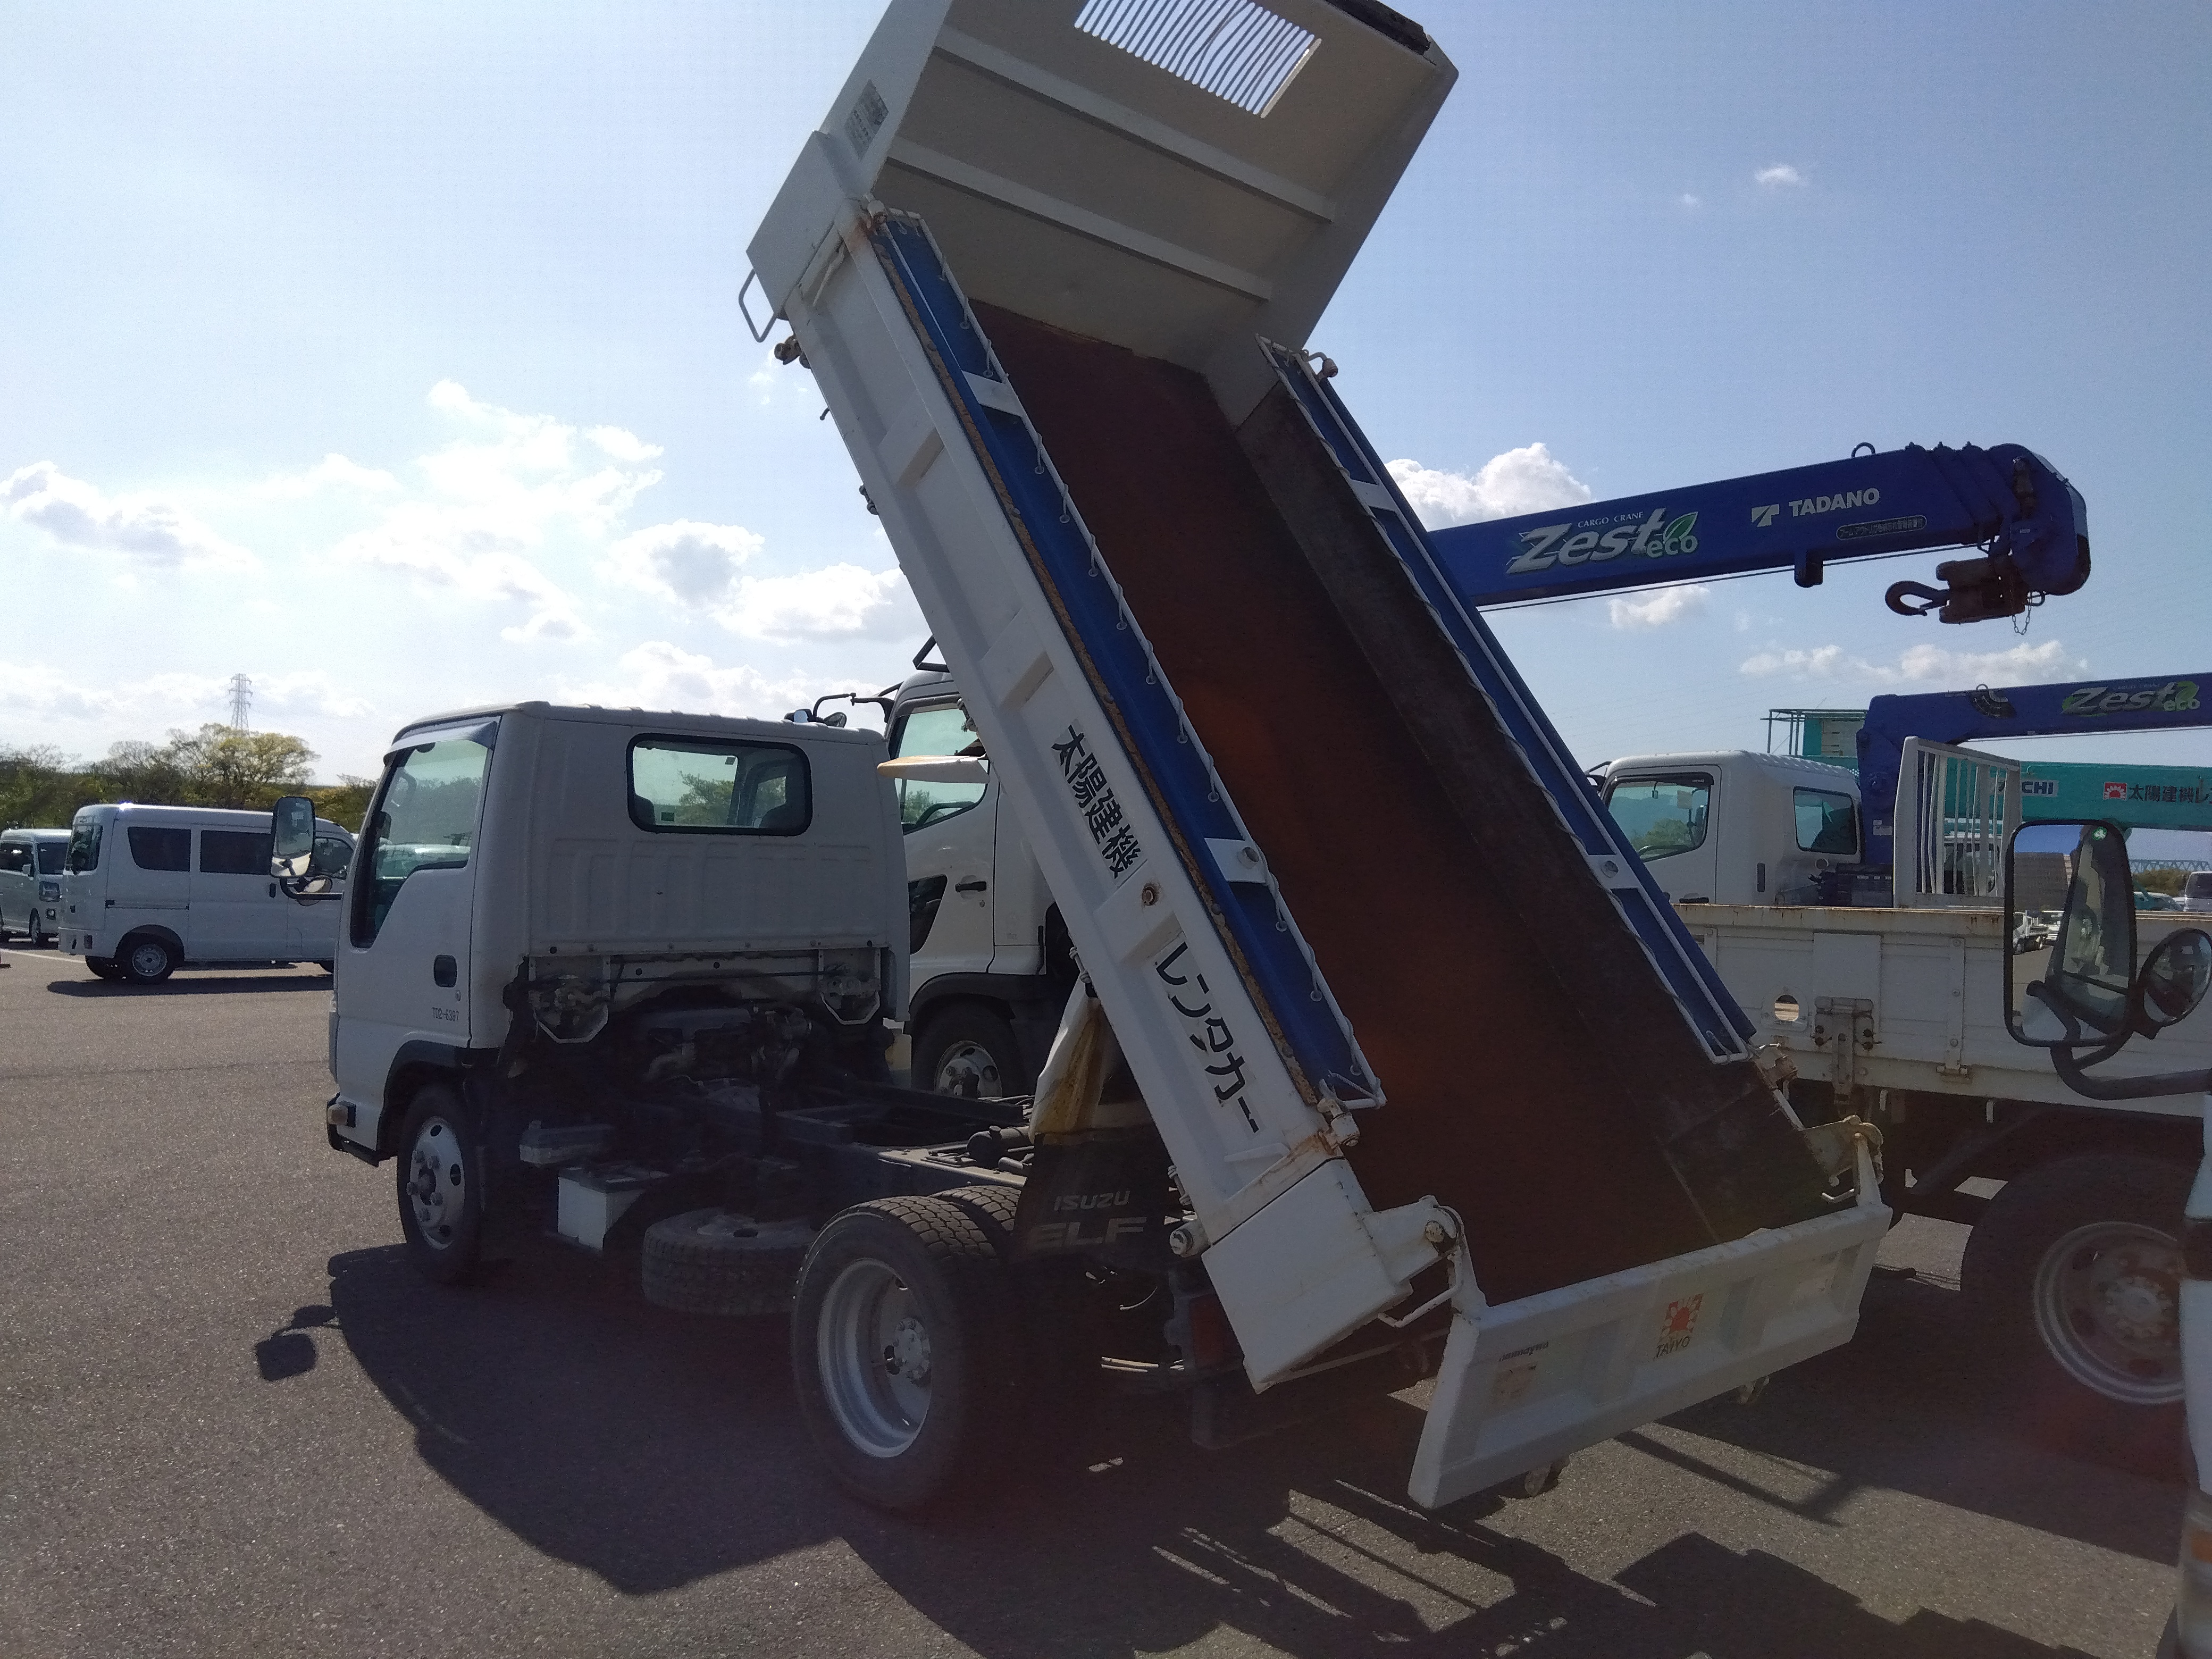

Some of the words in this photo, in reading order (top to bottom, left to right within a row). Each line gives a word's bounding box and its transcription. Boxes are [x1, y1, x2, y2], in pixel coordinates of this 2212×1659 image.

[1788, 488, 1880, 517] TADANO
[1577, 517, 1610, 528] CARGO
[1613, 511, 1644, 523] CRANE
[1505, 507, 1666, 574] Zest
[1646, 534, 1698, 558] eco
[2060, 682, 2176, 715] Zest
[2163, 698, 2201, 711] eco
[1051, 724, 1142, 879] 太陽建機
[1155, 941, 1260, 1134] レンタカー
[1053, 1190, 1130, 1211] ISUZU
[1028, 1216, 1148, 1250] ELF
